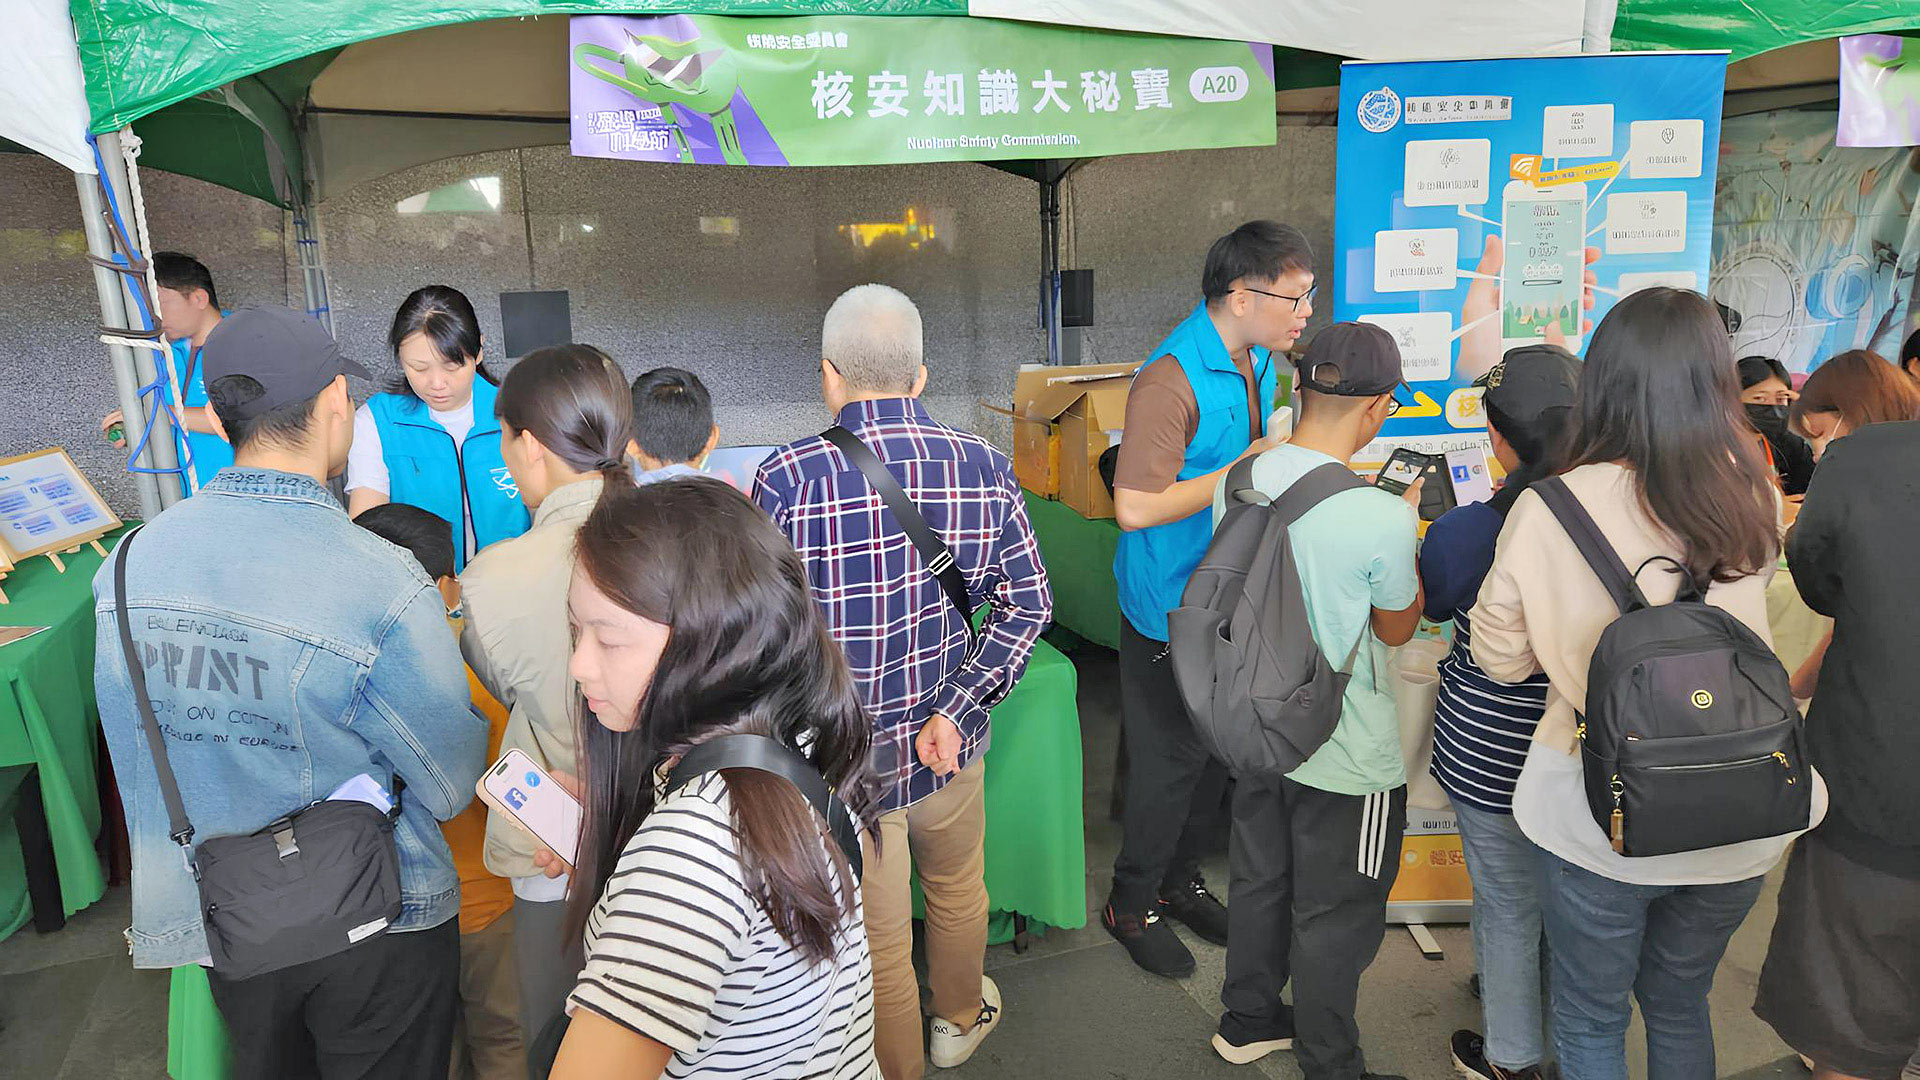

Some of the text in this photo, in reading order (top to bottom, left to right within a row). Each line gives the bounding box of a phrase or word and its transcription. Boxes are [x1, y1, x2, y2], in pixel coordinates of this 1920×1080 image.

[811, 68, 1173, 119] 核安知識大秘寶
[1202, 75, 1237, 95] A20
[186, 705, 216, 721] ON
